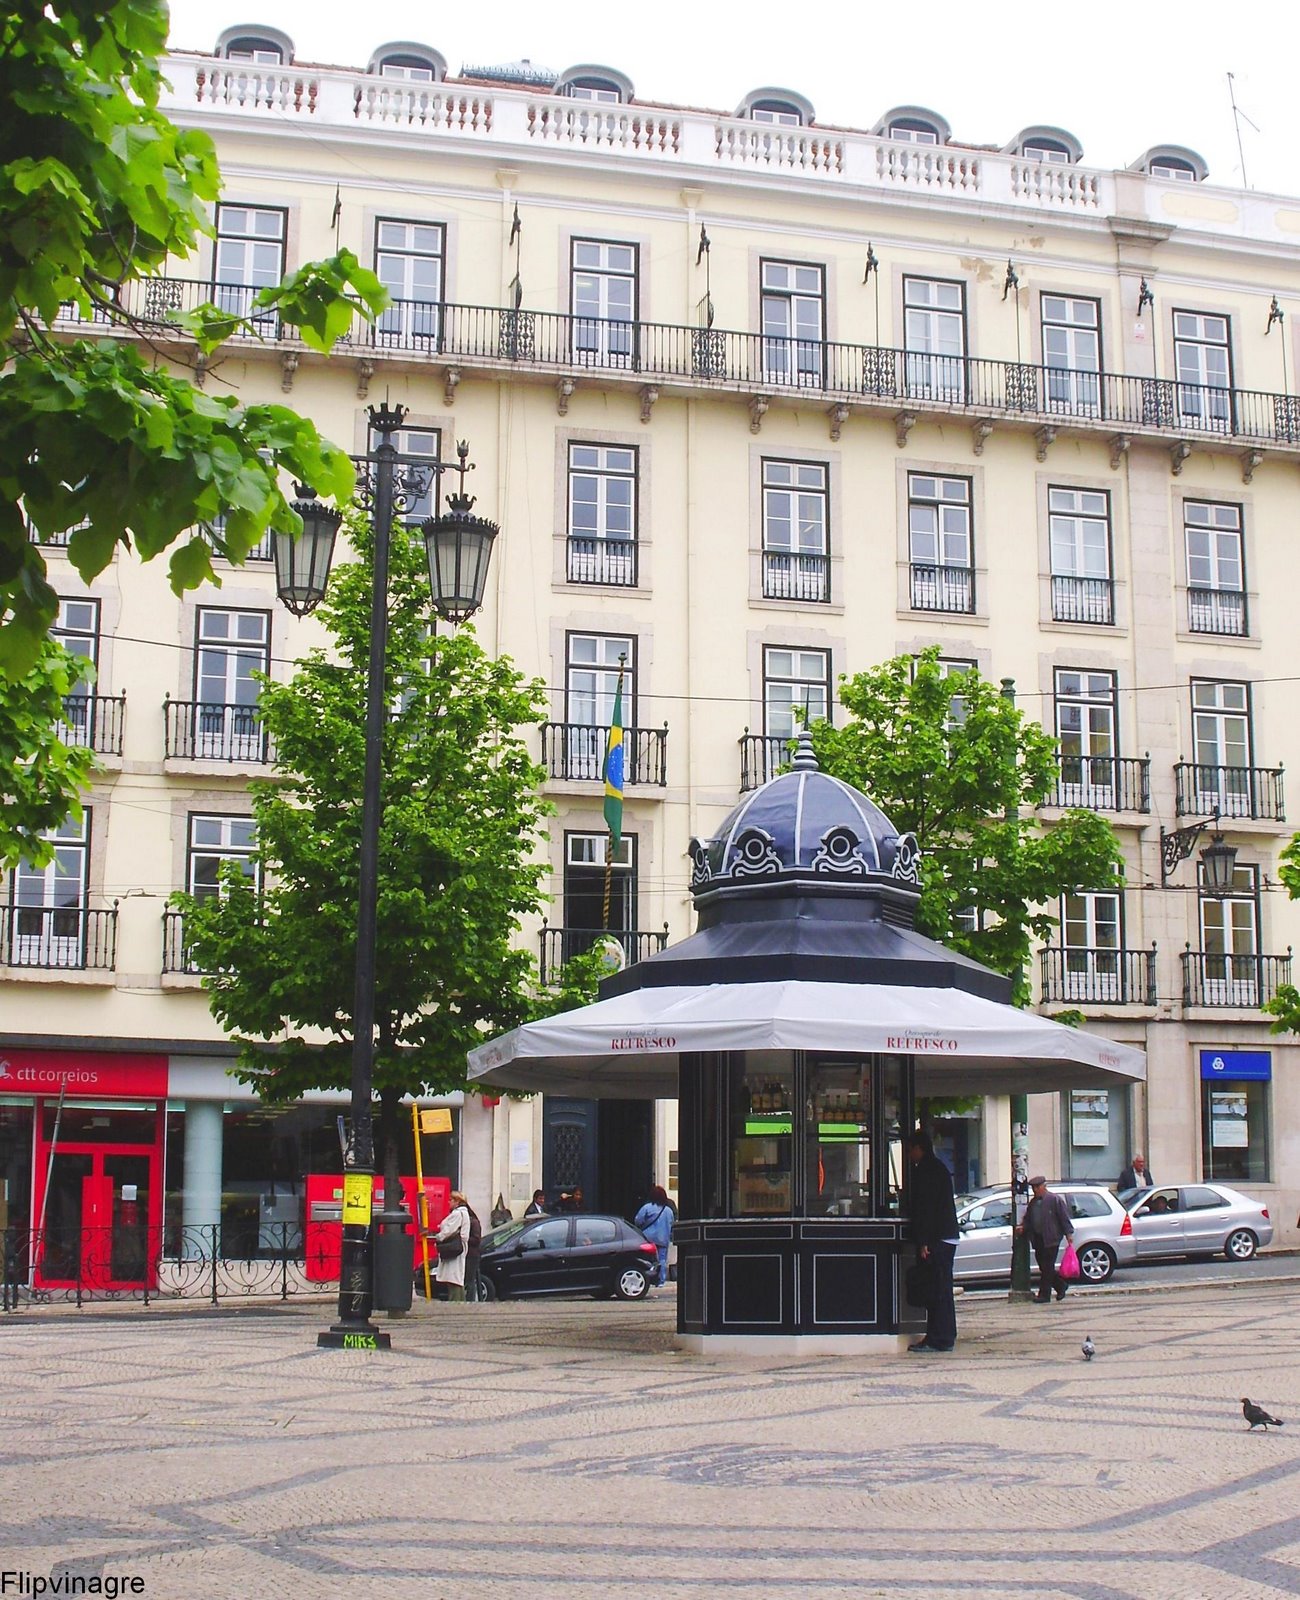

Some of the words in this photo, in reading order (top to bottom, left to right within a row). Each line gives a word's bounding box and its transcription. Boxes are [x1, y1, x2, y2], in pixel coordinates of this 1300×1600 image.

[611, 1036, 677, 1050] REFRESCO
[886, 1036, 958, 1051] REFRESCO
[17, 1067, 36, 1081] ctt
[38, 1068, 98, 1083] correios
